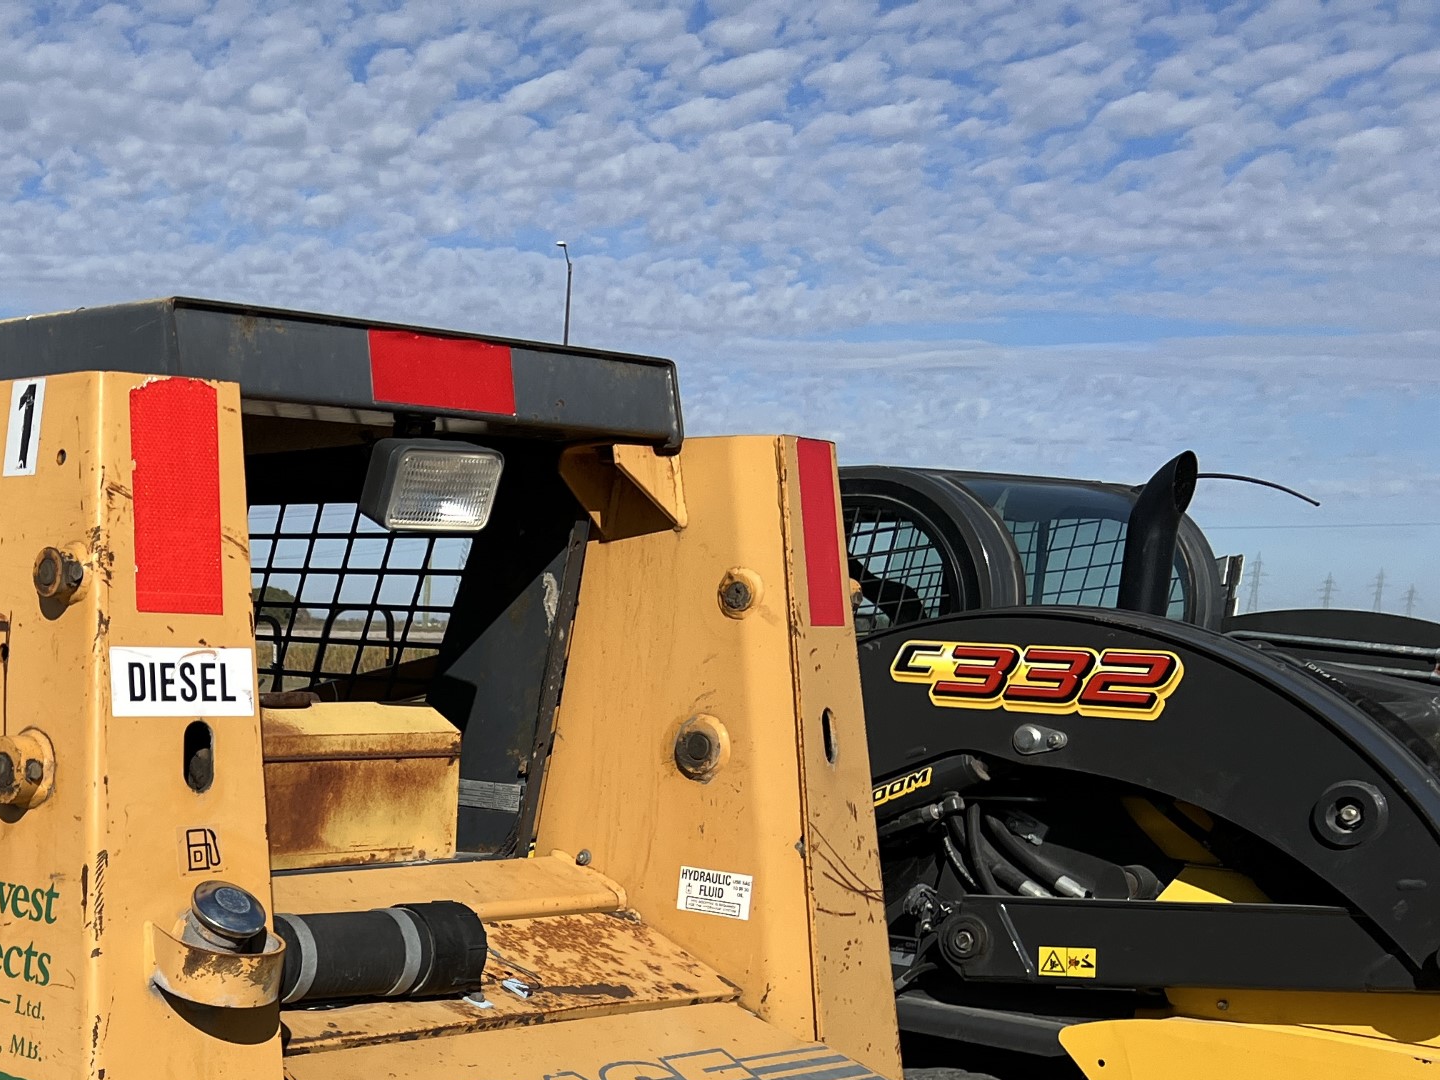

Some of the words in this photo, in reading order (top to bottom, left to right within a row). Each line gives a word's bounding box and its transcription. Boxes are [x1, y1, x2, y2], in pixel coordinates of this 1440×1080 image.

[18, 383, 37, 470] 1
[127, 661, 238, 704] DIESEL
[892, 641, 1182, 716] C332
[873, 767, 931, 804] OOM
[680, 868, 732, 886] HYDRAULIC
[698, 885, 724, 899] FLUID
[13, 994, 45, 1022] Ltd.
